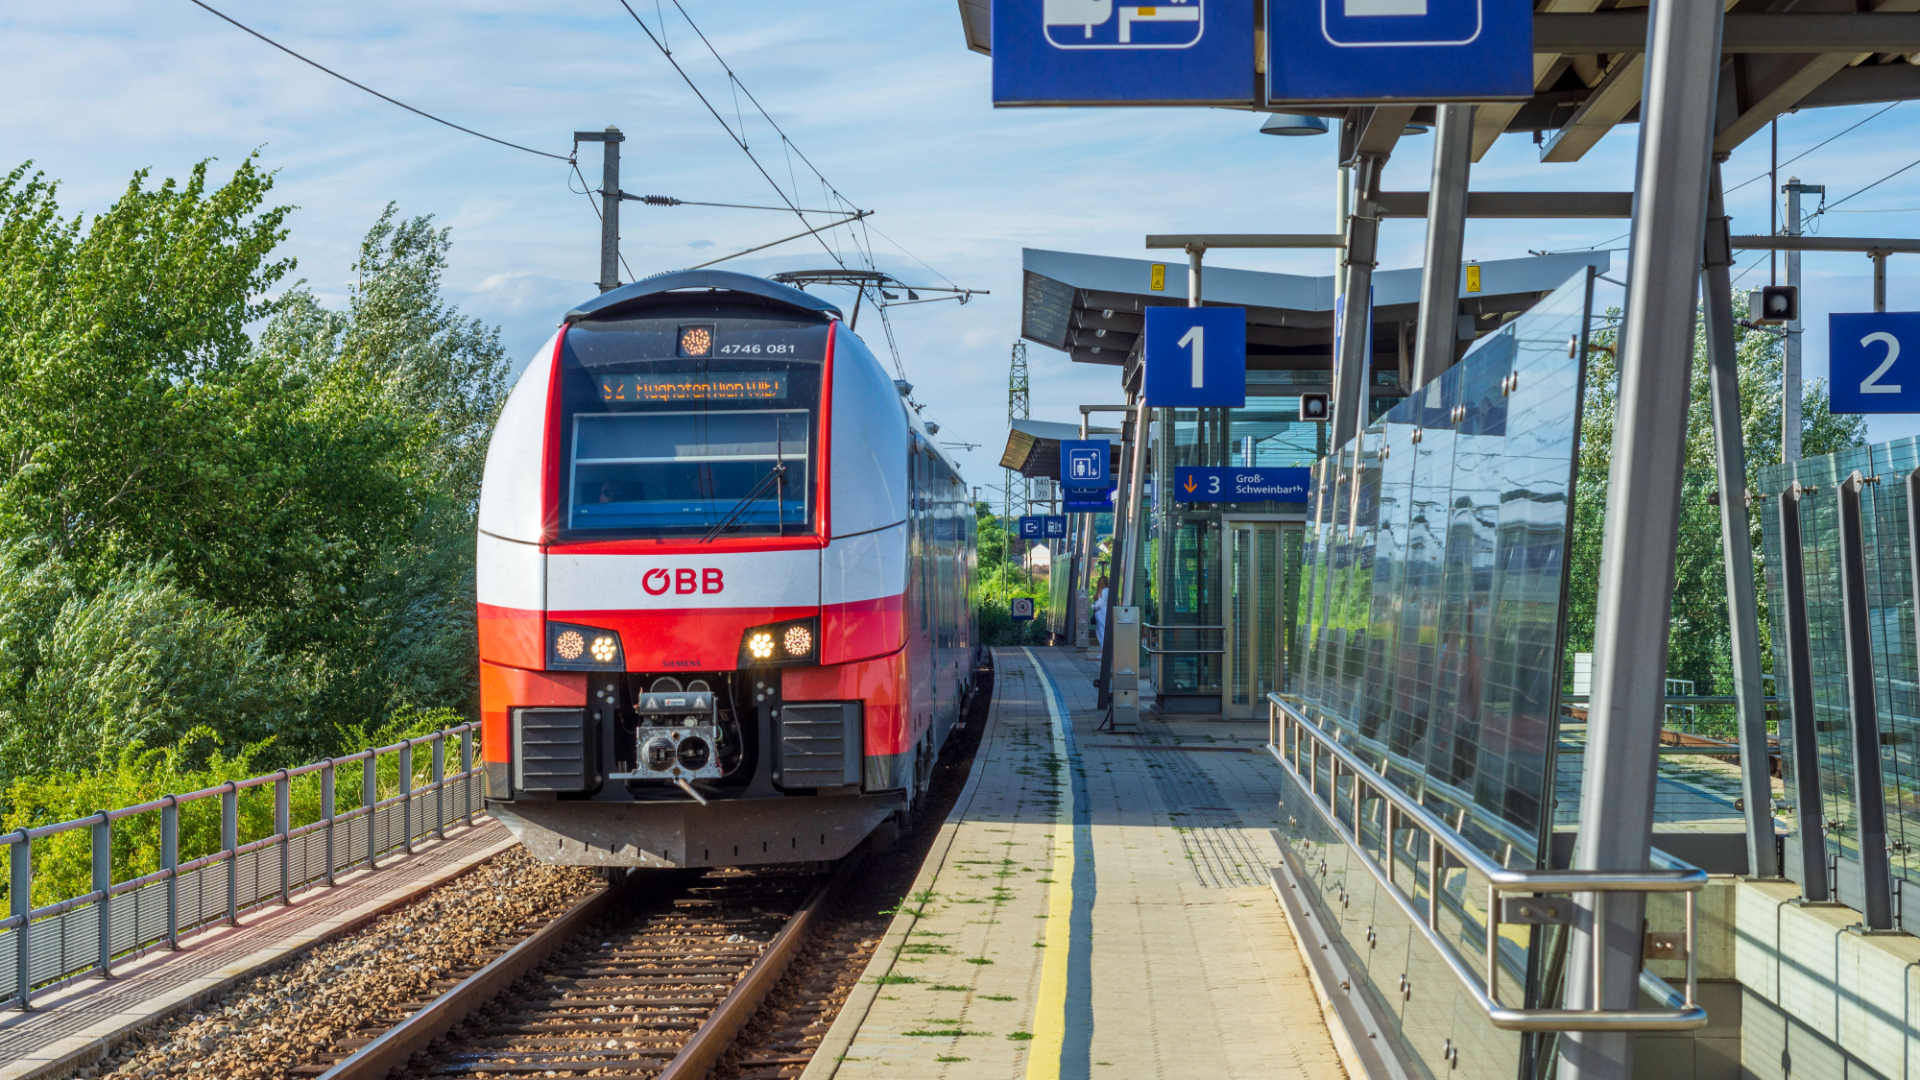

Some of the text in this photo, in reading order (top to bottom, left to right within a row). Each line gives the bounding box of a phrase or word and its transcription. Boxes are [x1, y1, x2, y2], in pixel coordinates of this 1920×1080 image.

[720, 343, 796, 355] 4746 081
[1177, 325, 1204, 389] 1
[1859, 331, 1902, 394] 2
[1208, 475, 1221, 494] 3
[1235, 473, 1265, 483] Groß-
[1235, 484, 1304, 494] Schweinbarth
[641, 567, 725, 596] ÖBB
[662, 659, 702, 668] SIEMENS
